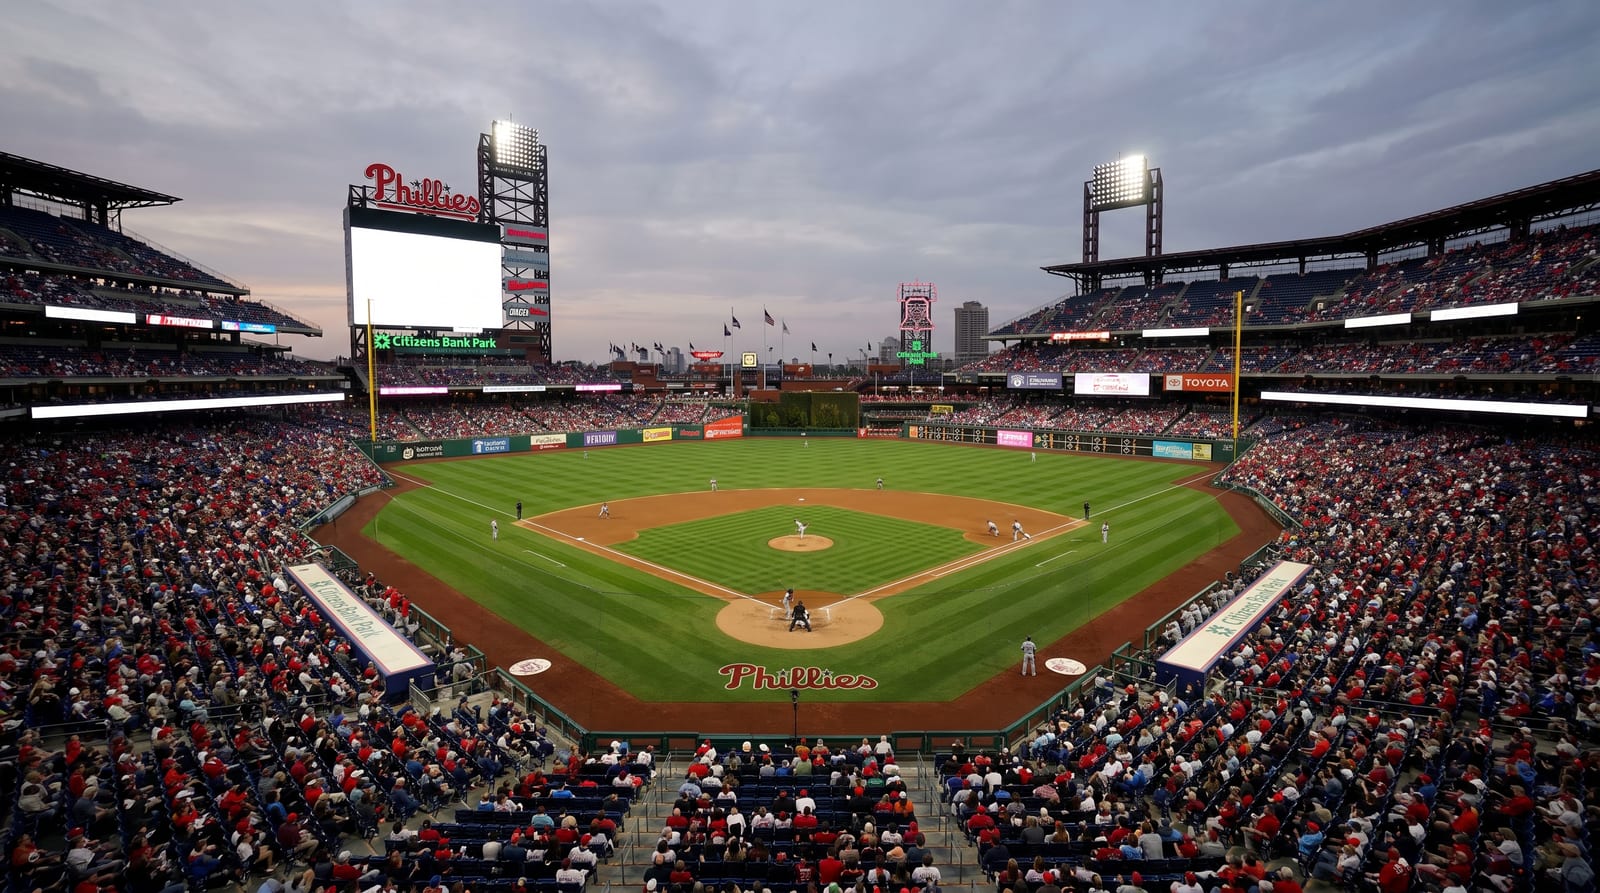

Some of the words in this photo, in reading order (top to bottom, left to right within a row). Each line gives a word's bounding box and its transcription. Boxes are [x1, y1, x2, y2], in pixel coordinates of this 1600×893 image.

[365, 163, 481, 214] Phillies
[392, 335, 440, 347] Citizens
[442, 337, 470, 348] Bank
[472, 338, 496, 348] Park
[1185, 379, 1229, 387] TOYOTA
[317, 587, 348, 609] Citizens
[336, 606, 368, 623] Bank
[352, 621, 384, 639] Park
[1222, 602, 1260, 625] Citizens
[718, 663, 879, 690] Phillies
